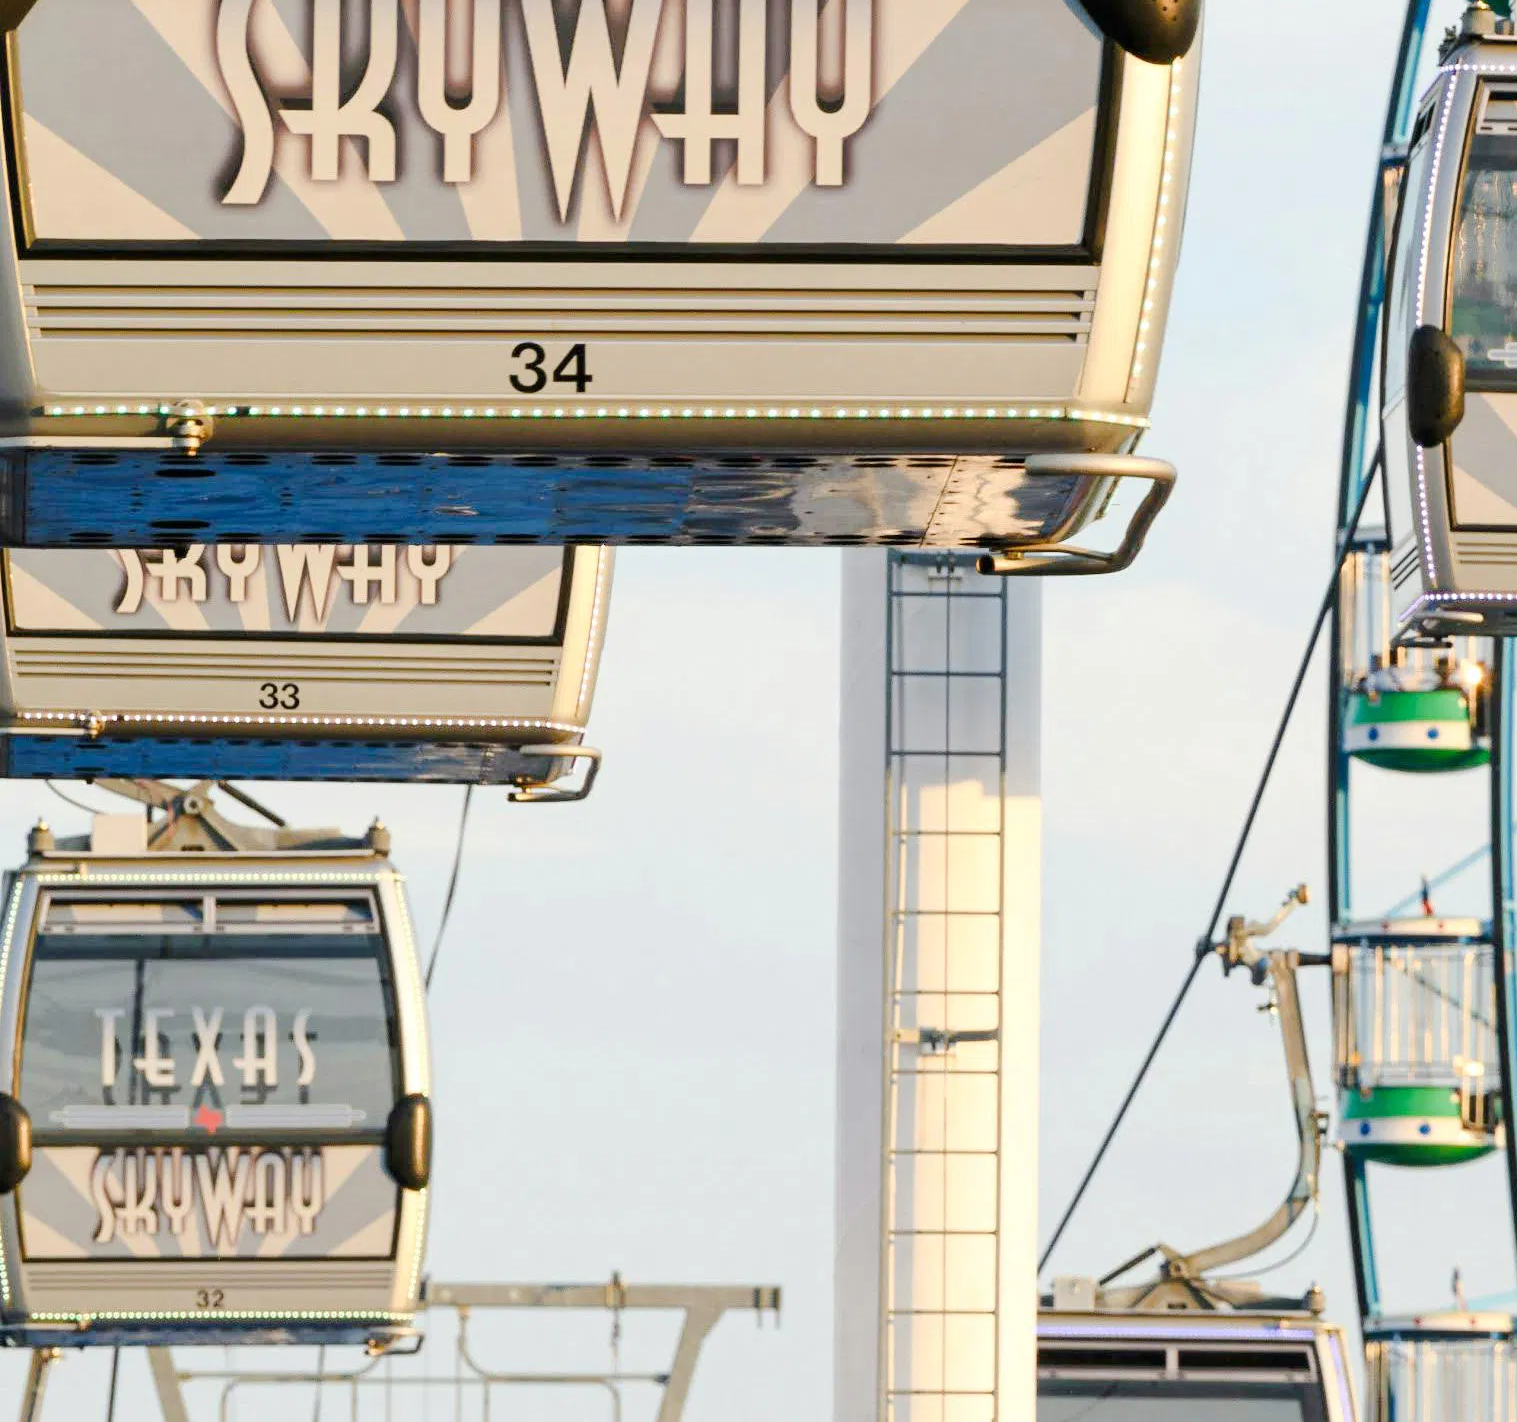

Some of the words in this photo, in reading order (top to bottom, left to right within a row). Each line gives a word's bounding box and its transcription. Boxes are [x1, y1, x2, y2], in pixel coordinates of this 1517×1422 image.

[509, 343, 594, 395] 34
[259, 682, 301, 710] 33
[95, 1006, 316, 1087] TEXAS
[91, 1147, 326, 1248] SKYWAY
[195, 1290, 226, 1309] 32
